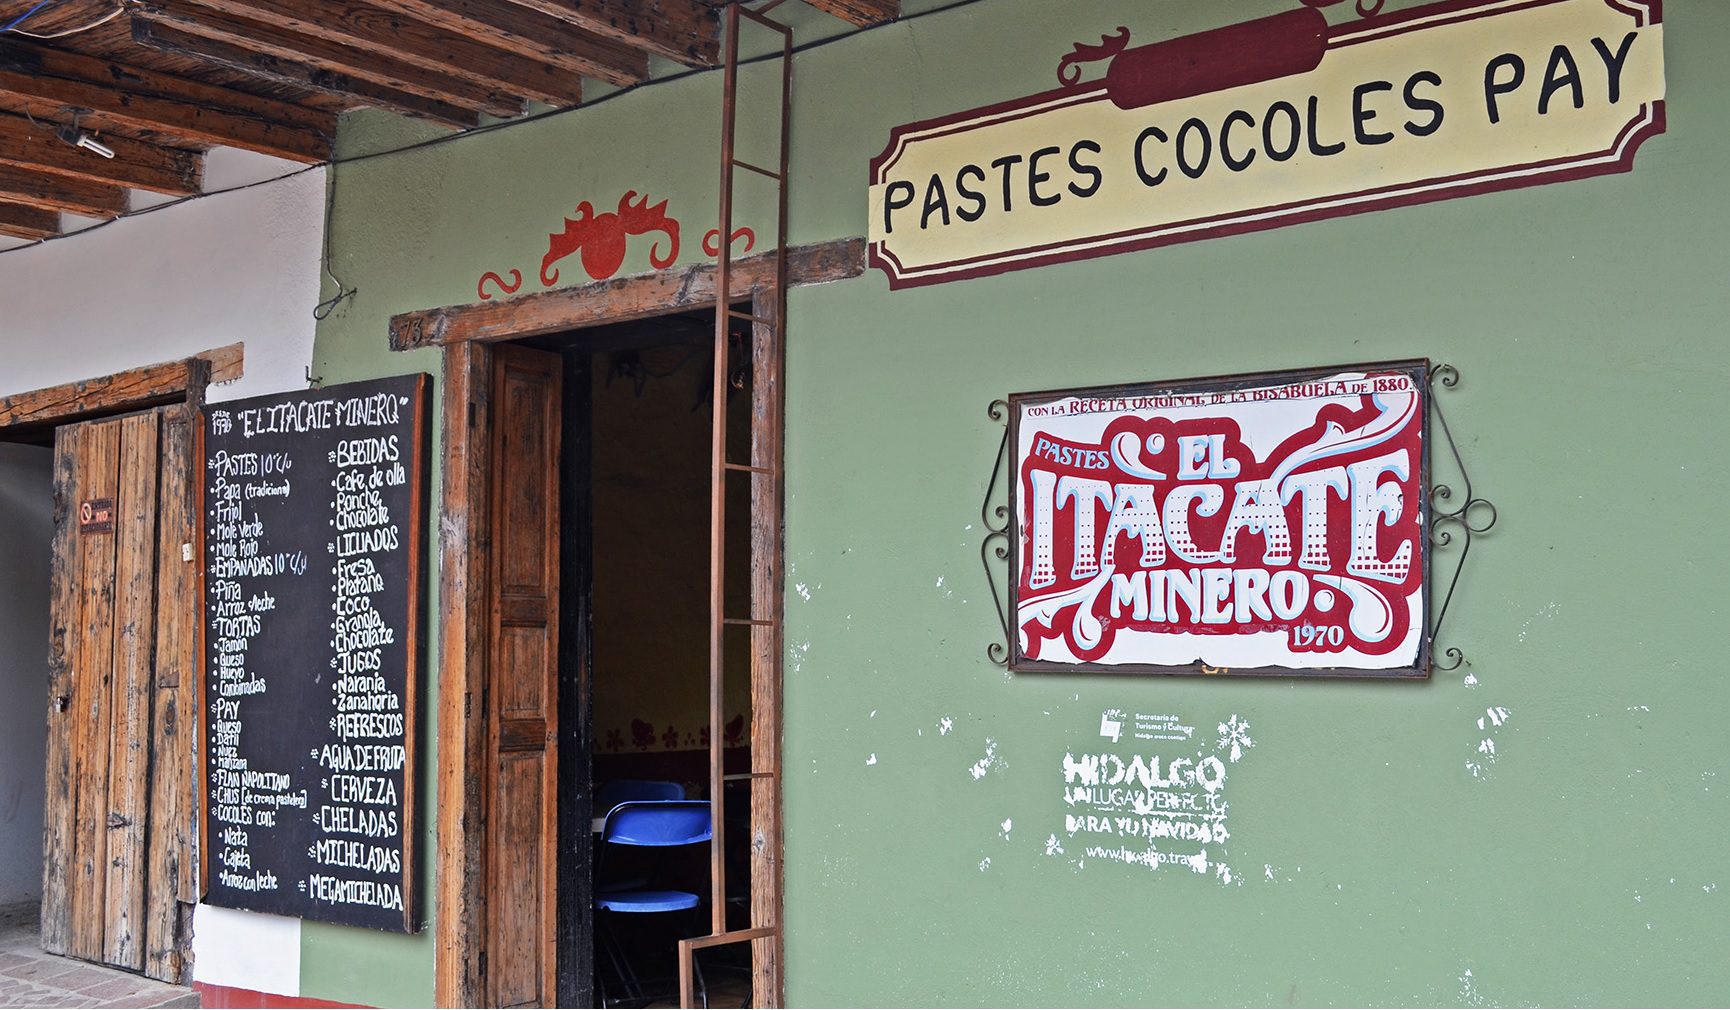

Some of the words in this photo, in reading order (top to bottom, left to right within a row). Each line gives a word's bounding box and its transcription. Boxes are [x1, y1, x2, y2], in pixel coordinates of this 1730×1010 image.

[884, 139, 1102, 234] PASTES
[1133, 70, 1444, 187] COCOLES
[1484, 32, 1638, 125] PAY
[1027, 407, 1049, 416] CON
[1051, 405, 1066, 415] LA
[1069, 398, 1128, 414] RECETA
[1211, 393, 1226, 404] DE
[1231, 392, 1247, 402] LA
[1253, 381, 1347, 401] BISABUELA
[1352, 383, 1368, 393] DE
[215, 450, 258, 477] PASTES
[337, 435, 400, 468] BEBIDAS
[1036, 438, 1111, 470] PASTES
[1176, 433, 1241, 480] EL
[215, 477, 241, 501] Papa
[336, 469, 365, 491] Cafe
[369, 465, 384, 489] de
[386, 462, 406, 486] olla
[336, 485, 380, 512] Ponche
[216, 521, 237, 541] Mole
[239, 512, 263, 538] Verde
[336, 500, 390, 530] Chocolate
[1029, 448, 1412, 590] ITACATE
[216, 539, 237, 557] Mole
[336, 524, 399, 557] LICUADOS
[215, 555, 274, 578] EMPANADAS
[337, 558, 375, 578] Fresa
[215, 579, 241, 601] Piña
[1110, 567, 1310, 624] MINERO
[216, 600, 246, 617] Arroz
[336, 607, 381, 634] Granola
[215, 614, 261, 639] TORTAS
[335, 621, 394, 653] Chocolate
[1292, 625, 1345, 647] 1970
[219, 652, 244, 667] Queso
[219, 666, 245, 680] Huevo
[337, 648, 382, 674] JUGOS
[337, 672, 386, 694] Naranja
[216, 697, 240, 719] PAY
[337, 690, 399, 711] Zanahoria
[217, 719, 242, 733] Queso
[337, 712, 403, 742] REFRESCOS
[1135, 722, 1162, 731] Turismo
[319, 744, 355, 773] AGUA
[354, 744, 374, 771] DE
[373, 745, 406, 772] FRUTA
[1063, 752, 1227, 788] HIDALGO
[216, 769, 240, 788] FLAN
[331, 774, 397, 806] CERVEZA
[217, 804, 253, 825] COCOLES
[321, 805, 398, 838] CHELADAS
[224, 825, 248, 846] Nata
[316, 839, 400, 874] MICHELADAS
[222, 869, 243, 889] Arroz
[309, 873, 404, 911] MEGAMICHELADA
